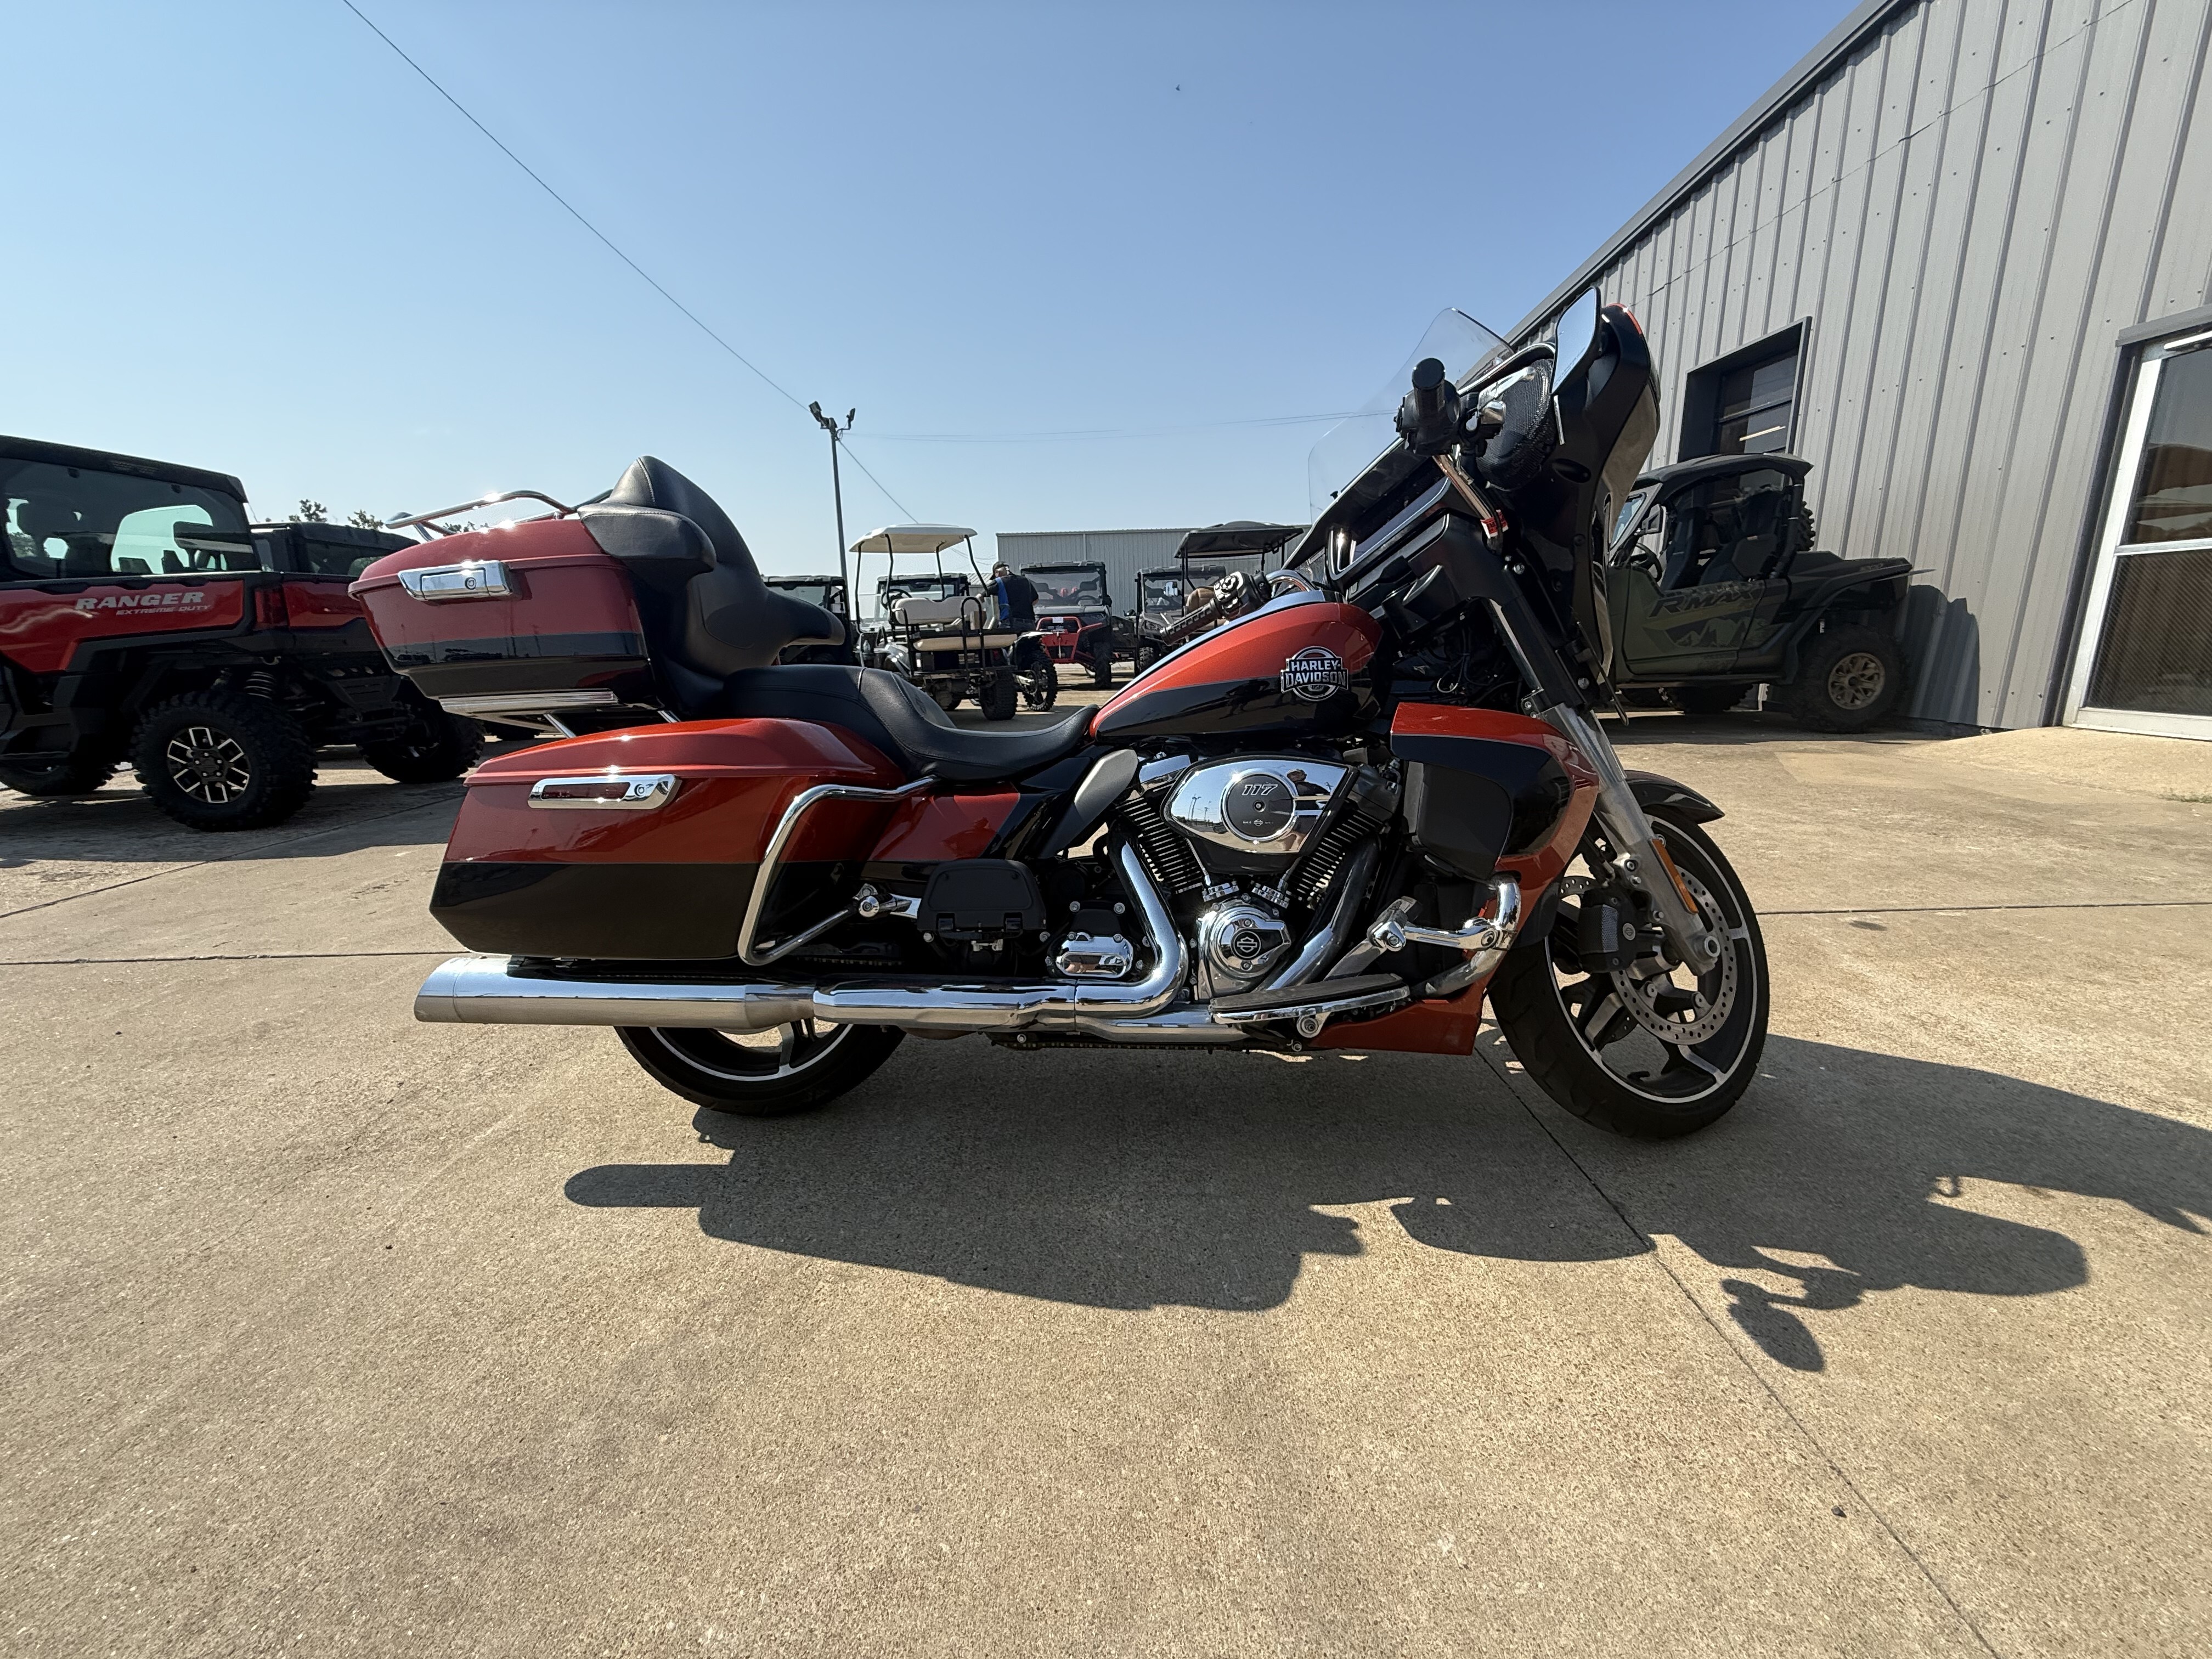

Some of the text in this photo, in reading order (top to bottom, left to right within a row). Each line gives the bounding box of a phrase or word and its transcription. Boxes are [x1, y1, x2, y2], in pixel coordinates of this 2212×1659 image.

[75, 592, 205, 610] RANGER
[1646, 588, 1754, 618] RMAX
[116, 607, 174, 615] EXTREME
[1291, 660, 1341, 671] HARLEY-
[1285, 672, 1346, 688] DAVIDSON
[1242, 784, 1278, 795] 117
